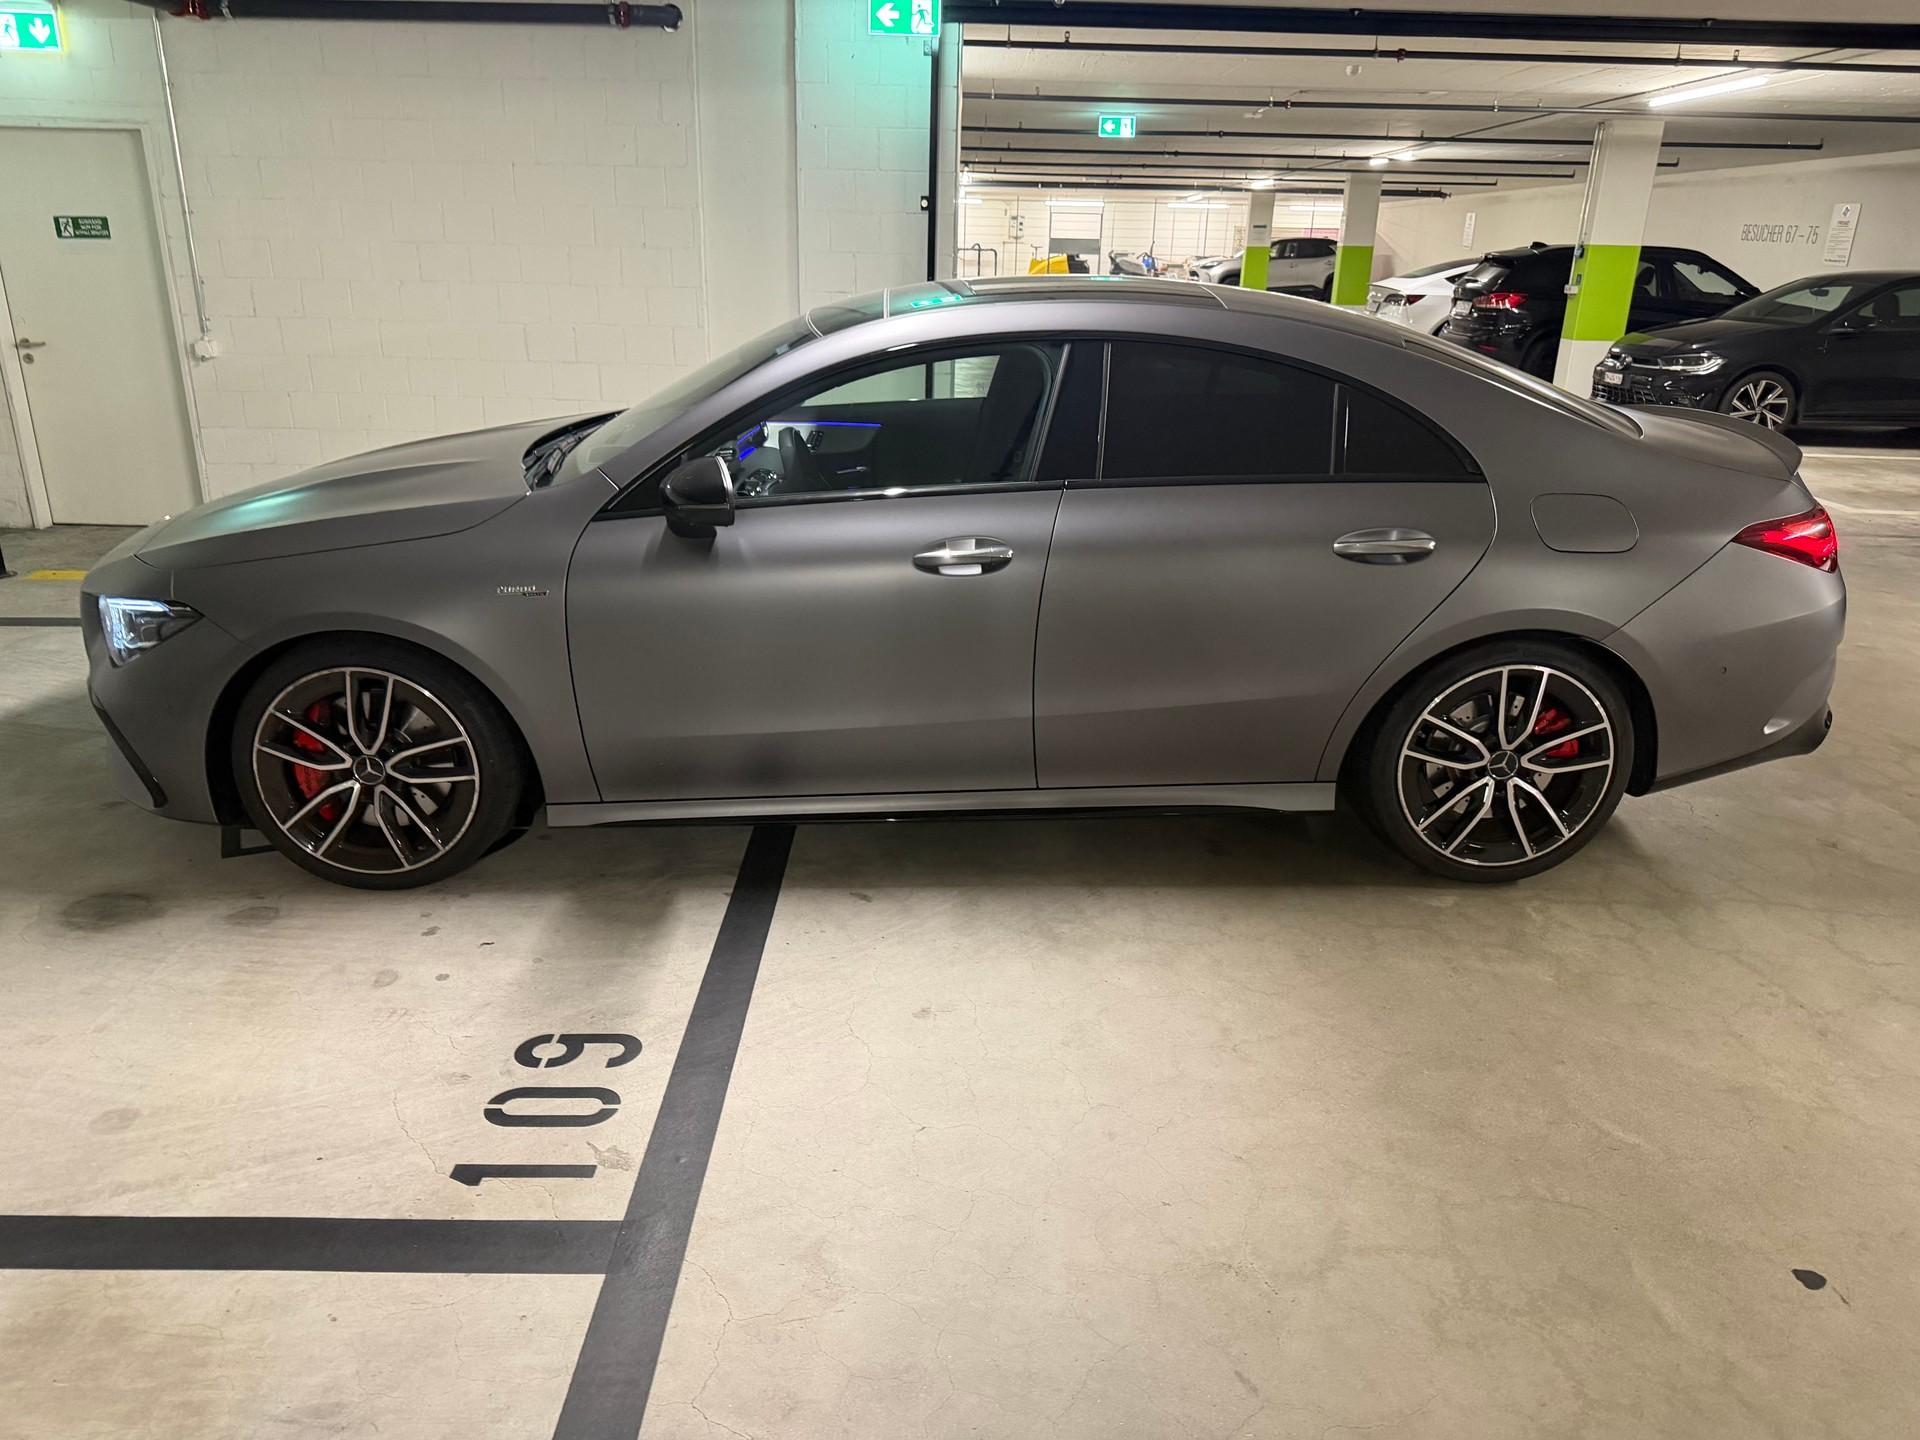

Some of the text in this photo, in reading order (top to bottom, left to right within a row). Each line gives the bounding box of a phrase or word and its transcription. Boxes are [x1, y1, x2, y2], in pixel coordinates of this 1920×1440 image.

[1741, 224, 1784, 242] BESUCHER
[1785, 225, 1798, 243] 67
[1806, 225, 1820, 244] 75
[449, 1033, 643, 1187] 109
